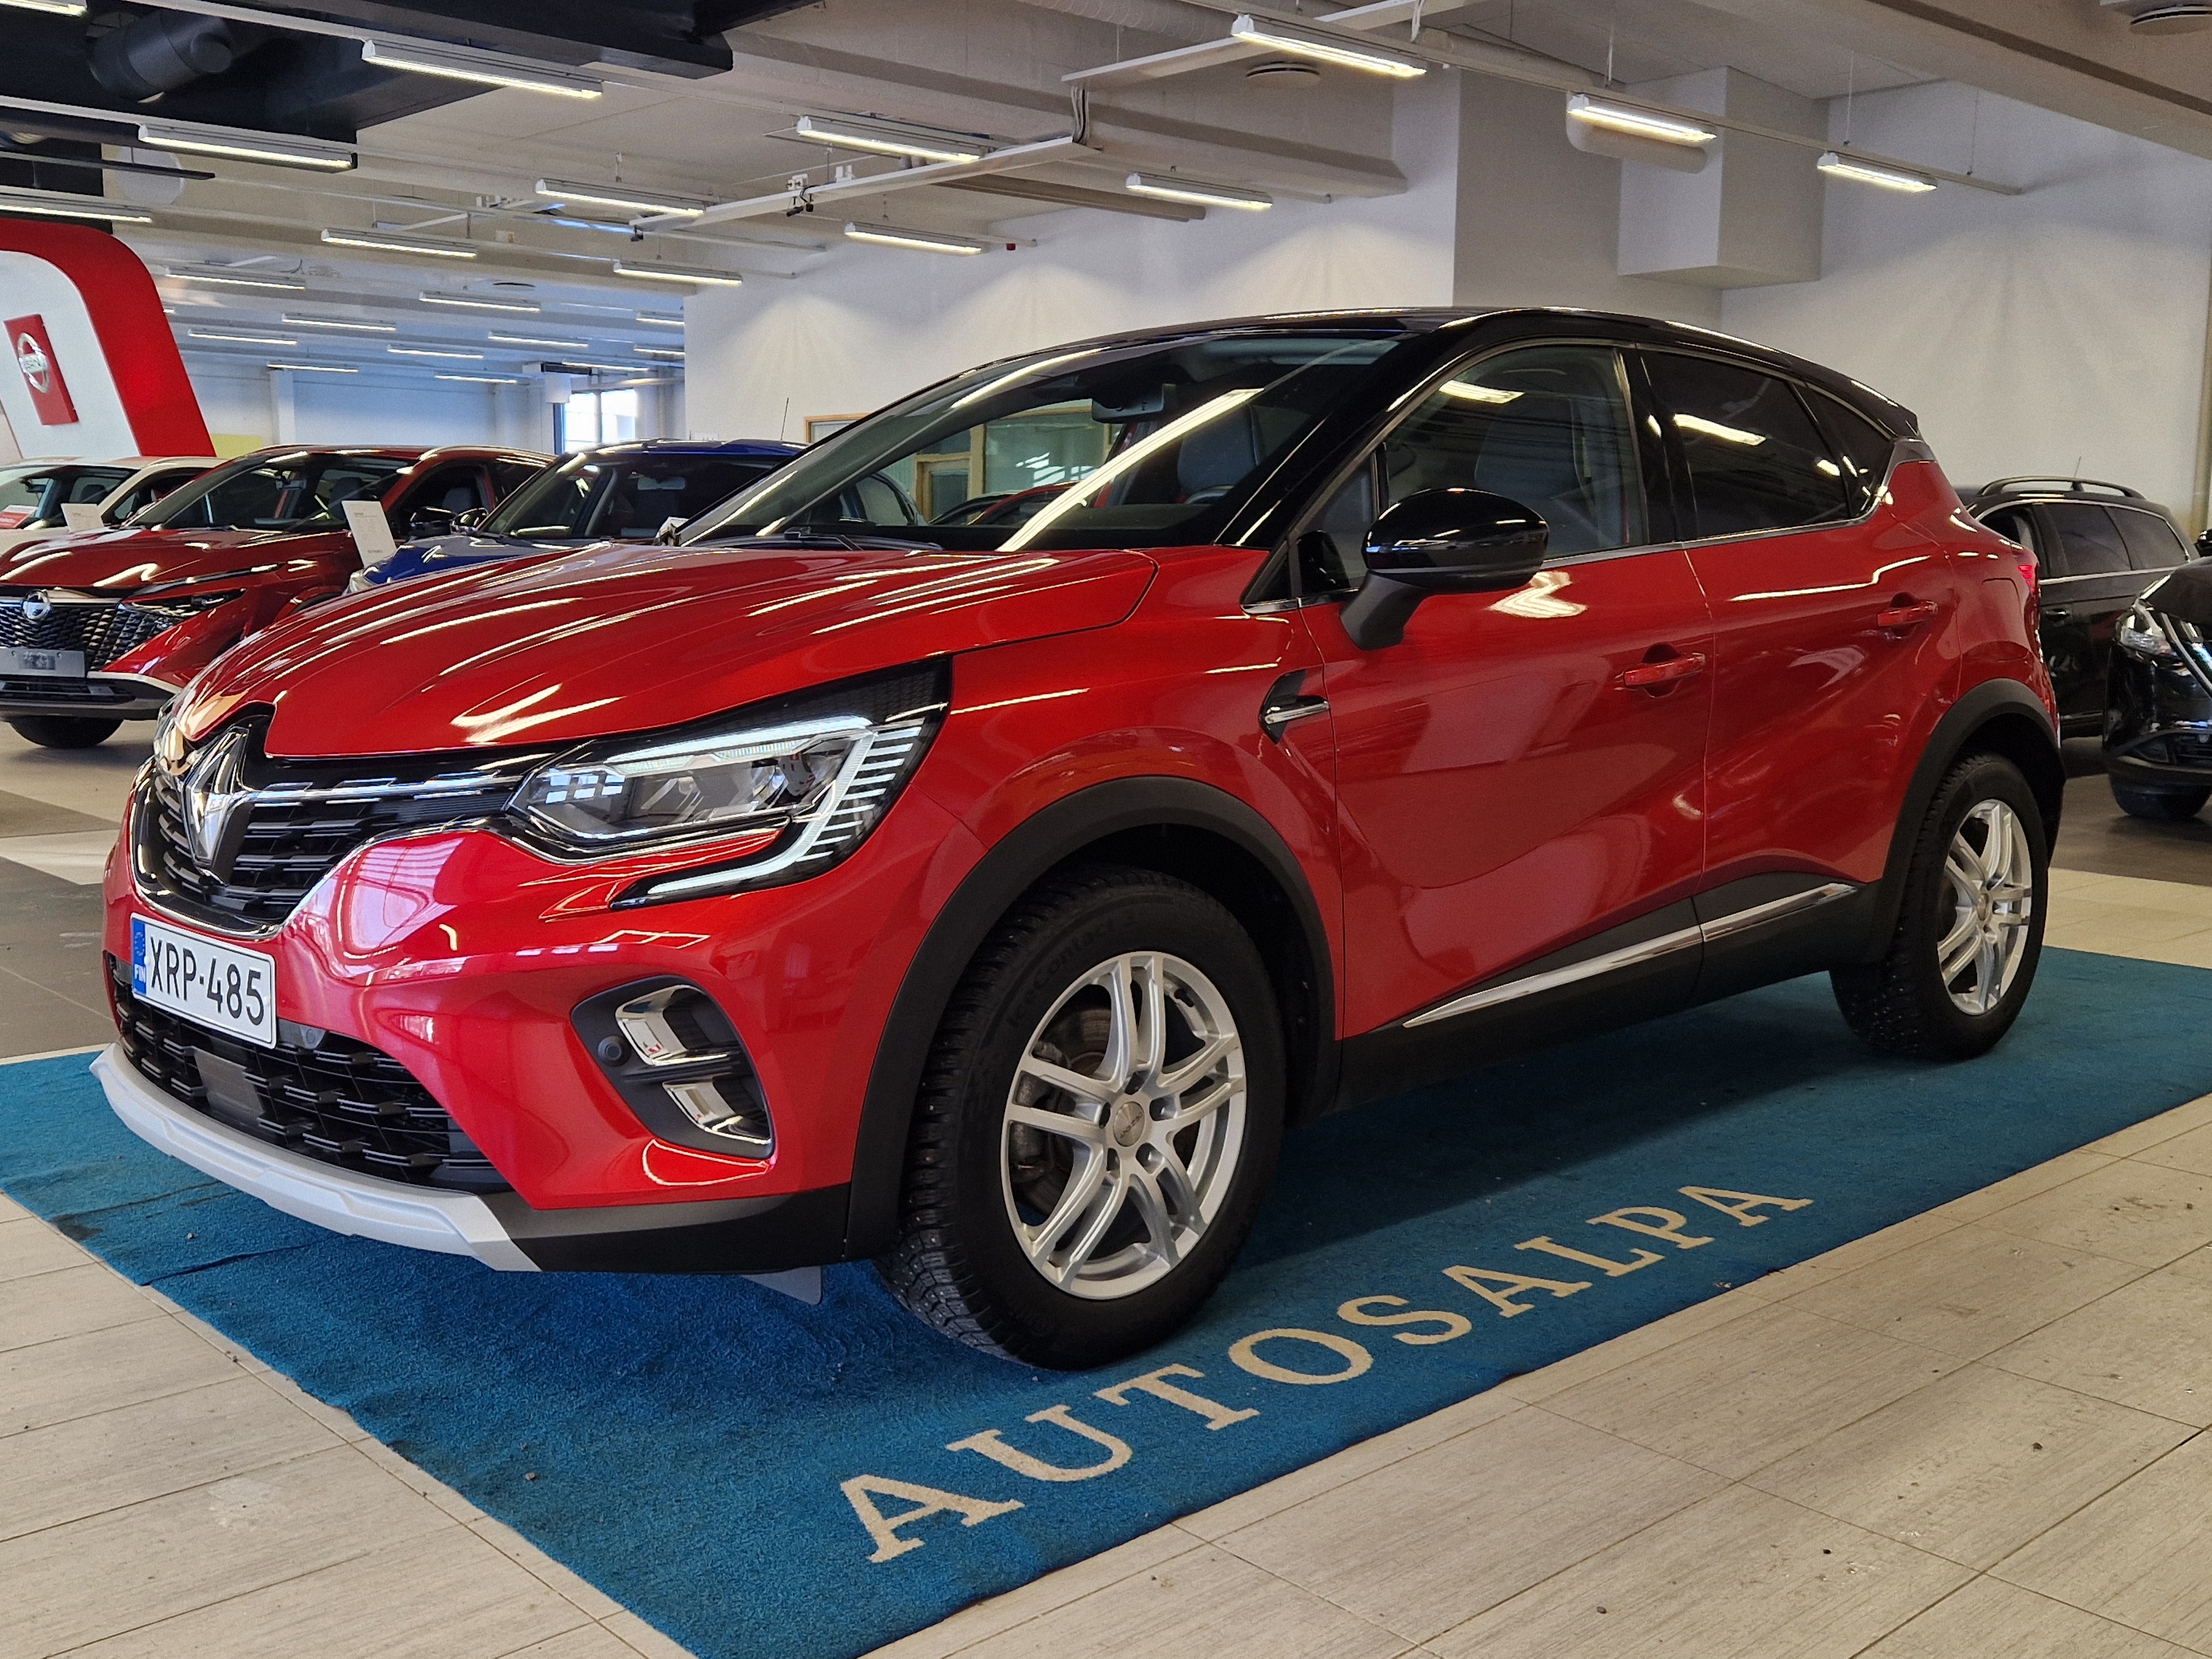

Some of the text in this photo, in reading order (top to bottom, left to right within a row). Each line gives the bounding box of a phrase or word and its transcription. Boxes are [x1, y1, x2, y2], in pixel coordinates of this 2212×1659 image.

[134, 963, 146, 984] FIN
[150, 936, 264, 1026] XRP-485
[840, 1185, 1814, 1563] AUTOSALPA
